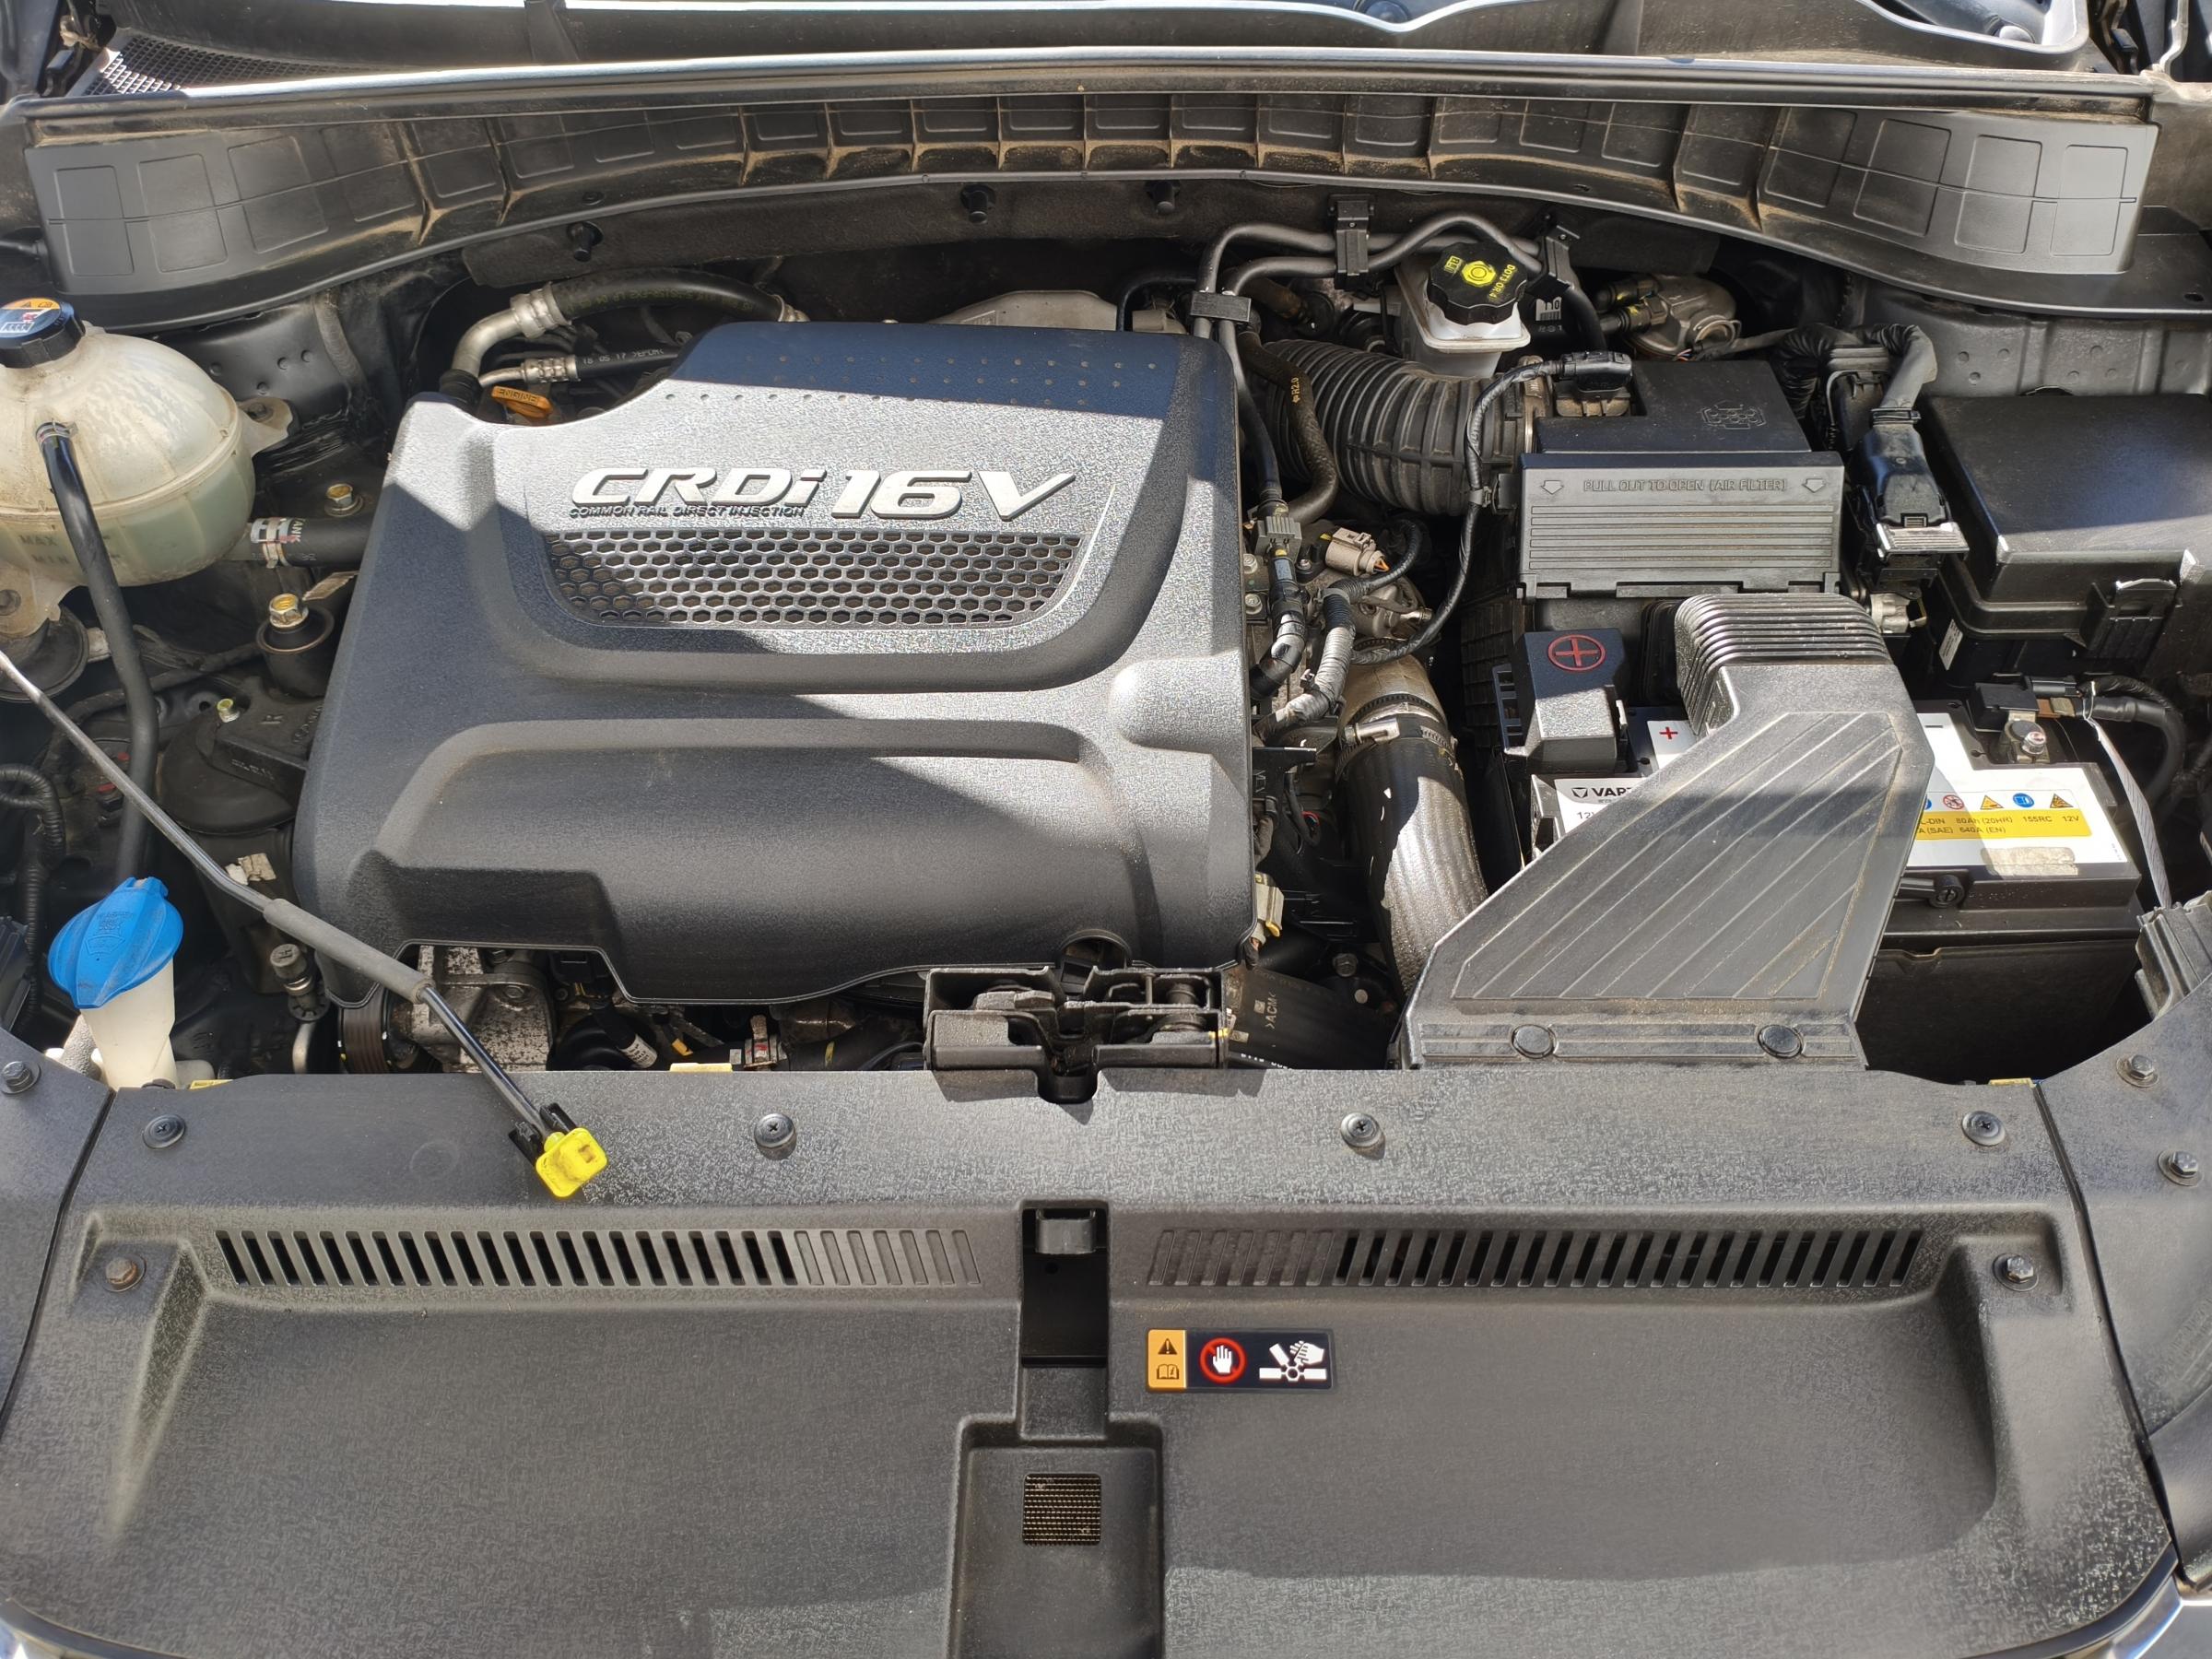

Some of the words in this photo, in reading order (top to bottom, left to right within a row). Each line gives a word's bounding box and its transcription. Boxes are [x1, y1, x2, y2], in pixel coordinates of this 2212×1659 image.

[1500, 264, 1516, 282] DOT3
[1492, 281, 1504, 293] OR
[499, 388, 538, 403] ENGINE
[571, 467, 828, 506] CRDi
[1583, 479, 1615, 492] PULL
[1618, 479, 1645, 492] OUT
[1648, 479, 1667, 492] TO
[1668, 479, 1704, 492] OPEN
[1709, 478, 1735, 492] (AIR
[1738, 478, 1786, 492] FILTER)
[570, 506, 636, 518] COMMON
[637, 506, 668, 517] RAIL
[673, 506, 726, 517] DIRECT
[728, 506, 806, 517] INJECTION
[1591, 787, 1632, 797] VAR
[1577, 811, 1594, 819] 12
